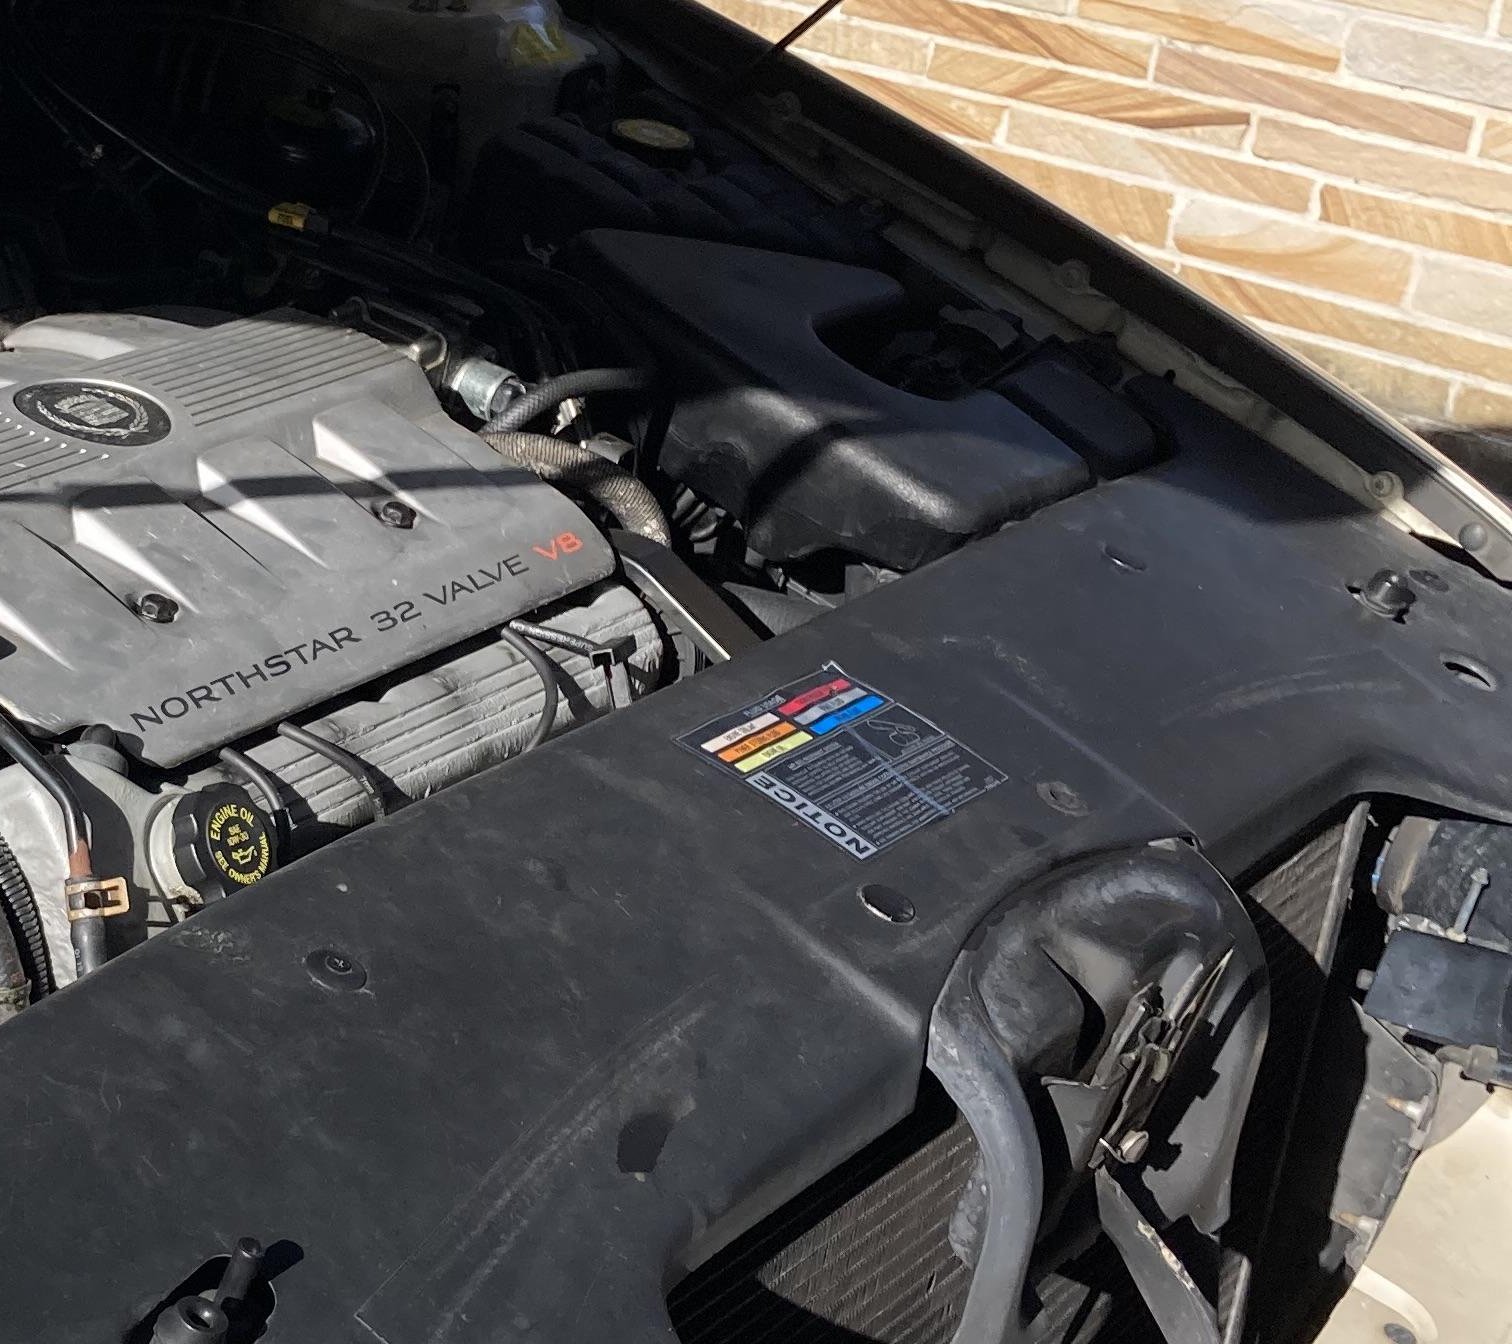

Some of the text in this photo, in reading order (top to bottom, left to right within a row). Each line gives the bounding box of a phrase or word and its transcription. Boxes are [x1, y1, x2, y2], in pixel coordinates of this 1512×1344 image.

[130, 531, 584, 732] NORTHSTAR 32 VALVE V8
[210, 804, 255, 841] ENGINE OIL
[753, 775, 870, 856] NOTICE
[214, 831, 270, 885] SEE OWNER'S MANUAL
